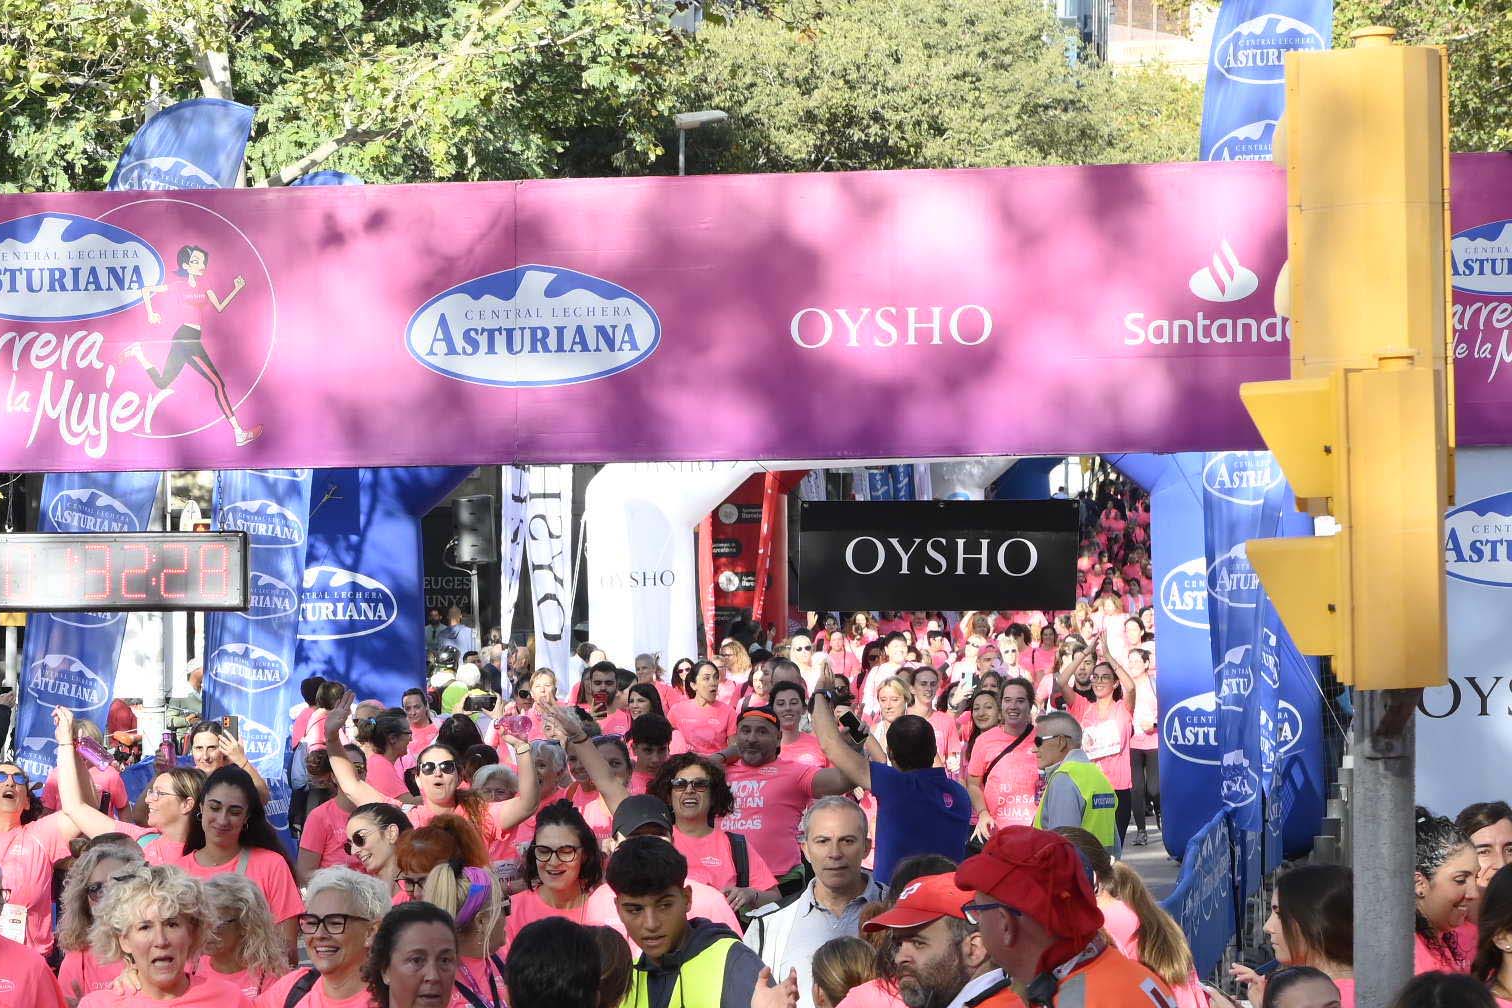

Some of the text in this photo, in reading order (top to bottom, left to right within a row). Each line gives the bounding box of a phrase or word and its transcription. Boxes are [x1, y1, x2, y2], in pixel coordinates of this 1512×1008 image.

[1224, 42, 1300, 69] ASTURI
[66, 248, 140, 260] LECHERA
[1464, 246, 1512, 255] CENTRA
[465, 305, 633, 321] CENTRAL LECHERA
[790, 304, 993, 349] OYSHO
[426, 313, 641, 358] ASTURIANA
[1474, 333, 1492, 360] la
[5, 378, 30, 414] la
[26, 365, 174, 458] Mujer
[844, 536, 1039, 577] OYSHO
[250, 595, 291, 610] RIANA
[334, 591, 383, 600] LECHERA
[1417, 675, 1512, 719] OY
[997, 807, 1030, 817] SUMA
